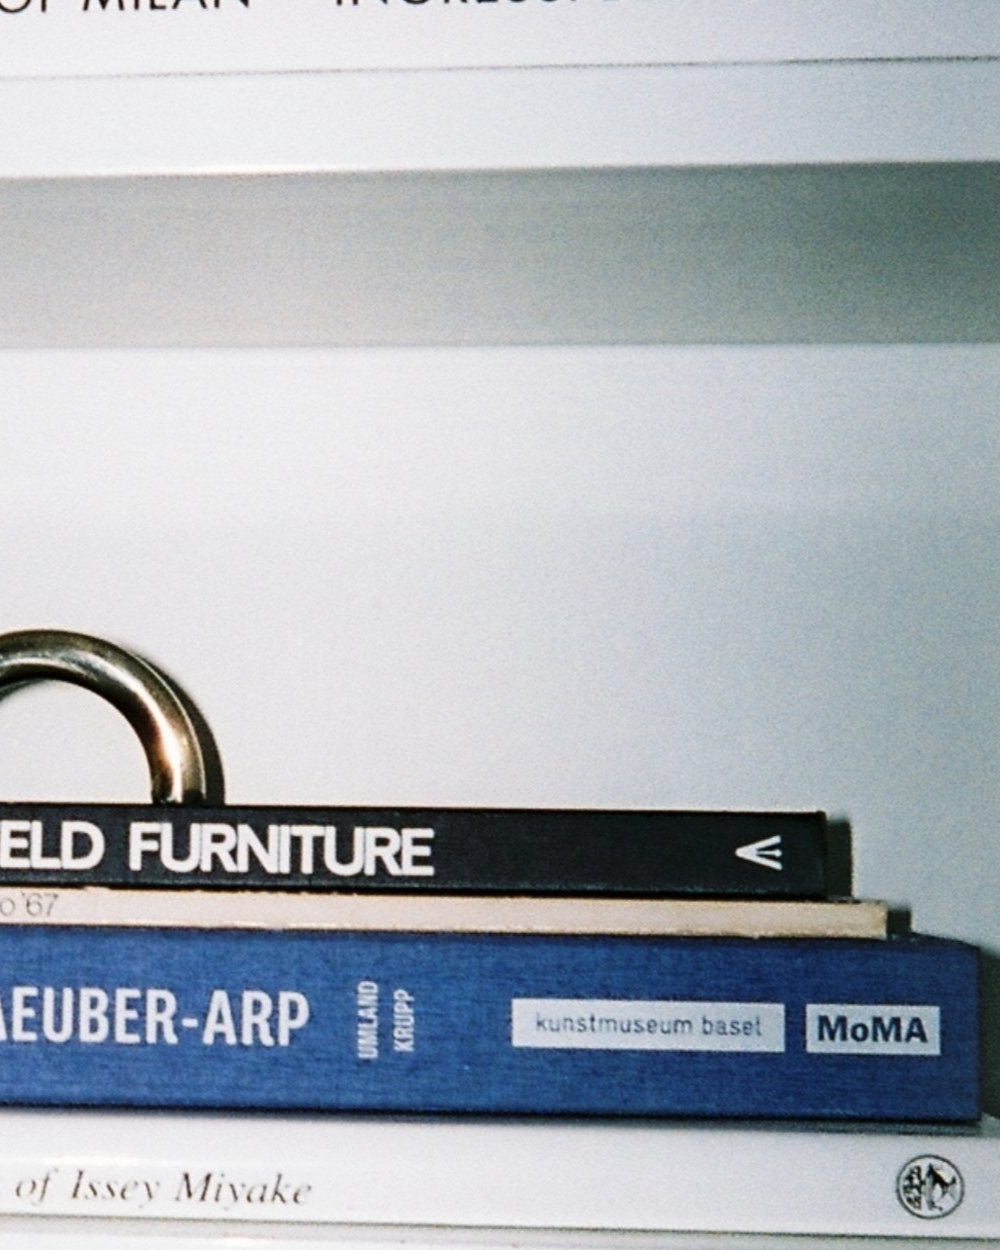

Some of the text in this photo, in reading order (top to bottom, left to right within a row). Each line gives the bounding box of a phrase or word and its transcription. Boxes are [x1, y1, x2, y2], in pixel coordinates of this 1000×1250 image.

[128, 821, 435, 877] FURNITURE
[357, 980, 379, 1059] UMLAND
[393, 988, 415, 1052] KRUPP
[536, 1013, 764, 1037] kunstmuseum basel
[817, 1014, 929, 1044] MoMA
[14, 1168, 56, 1203] of
[70, 1170, 160, 1205] Issey
[175, 1173, 313, 1206] Miyake
